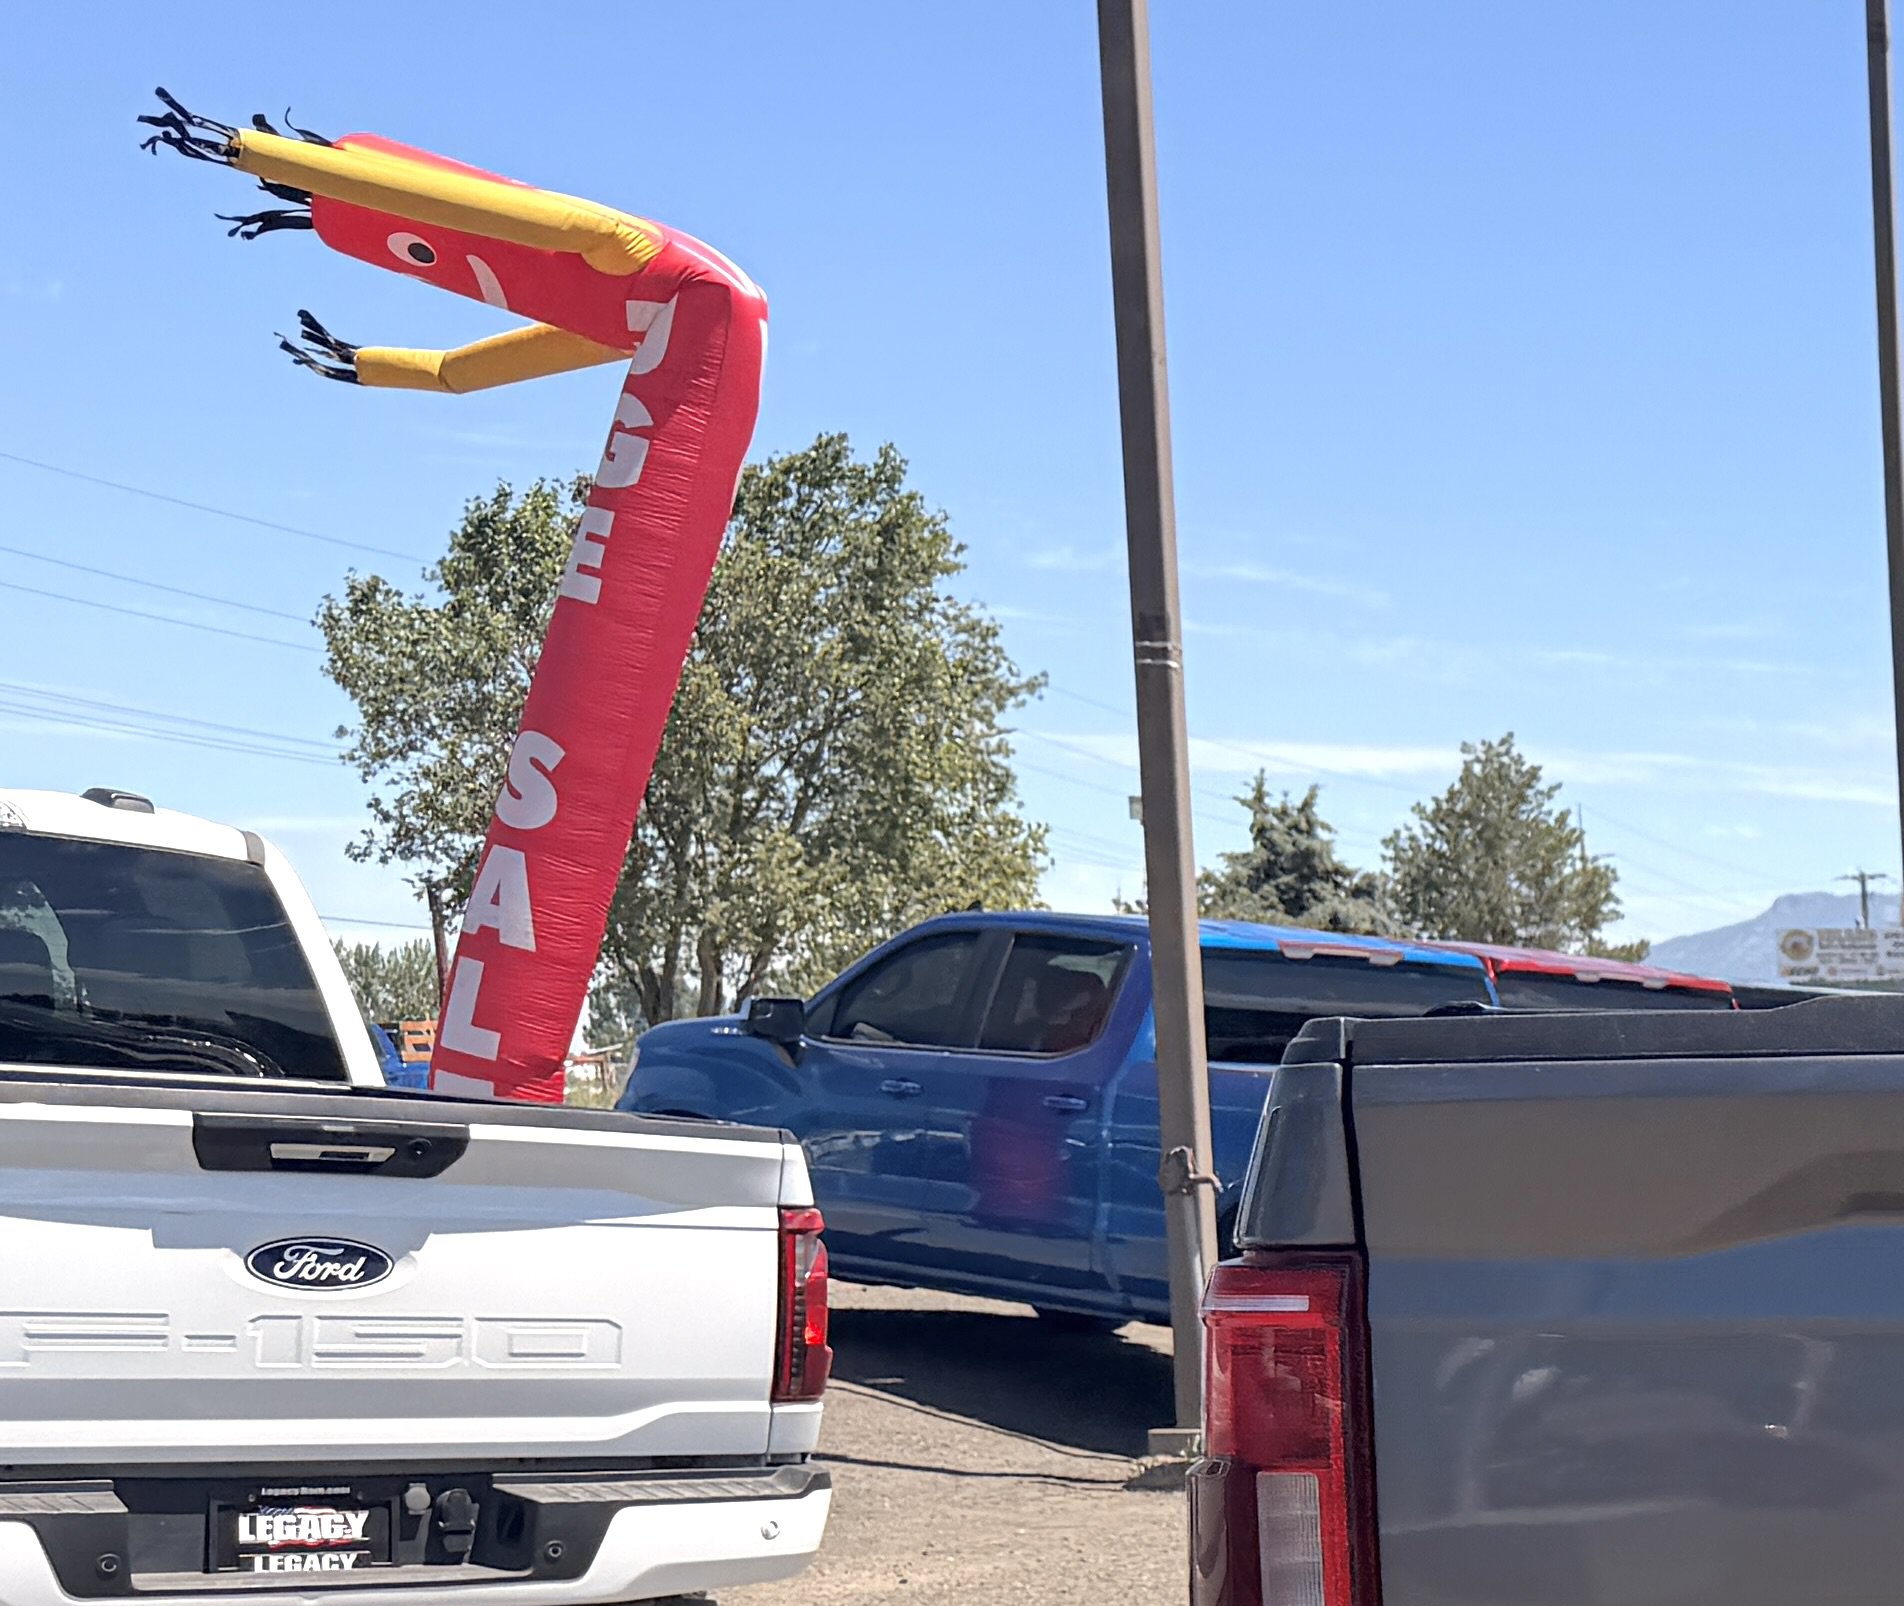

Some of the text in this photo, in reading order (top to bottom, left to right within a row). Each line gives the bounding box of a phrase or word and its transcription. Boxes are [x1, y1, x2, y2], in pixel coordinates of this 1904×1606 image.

[273, 1245, 368, 1282] Ford
[238, 1510, 369, 1544] LEGACY
[254, 1552, 358, 1573] LEGACY
